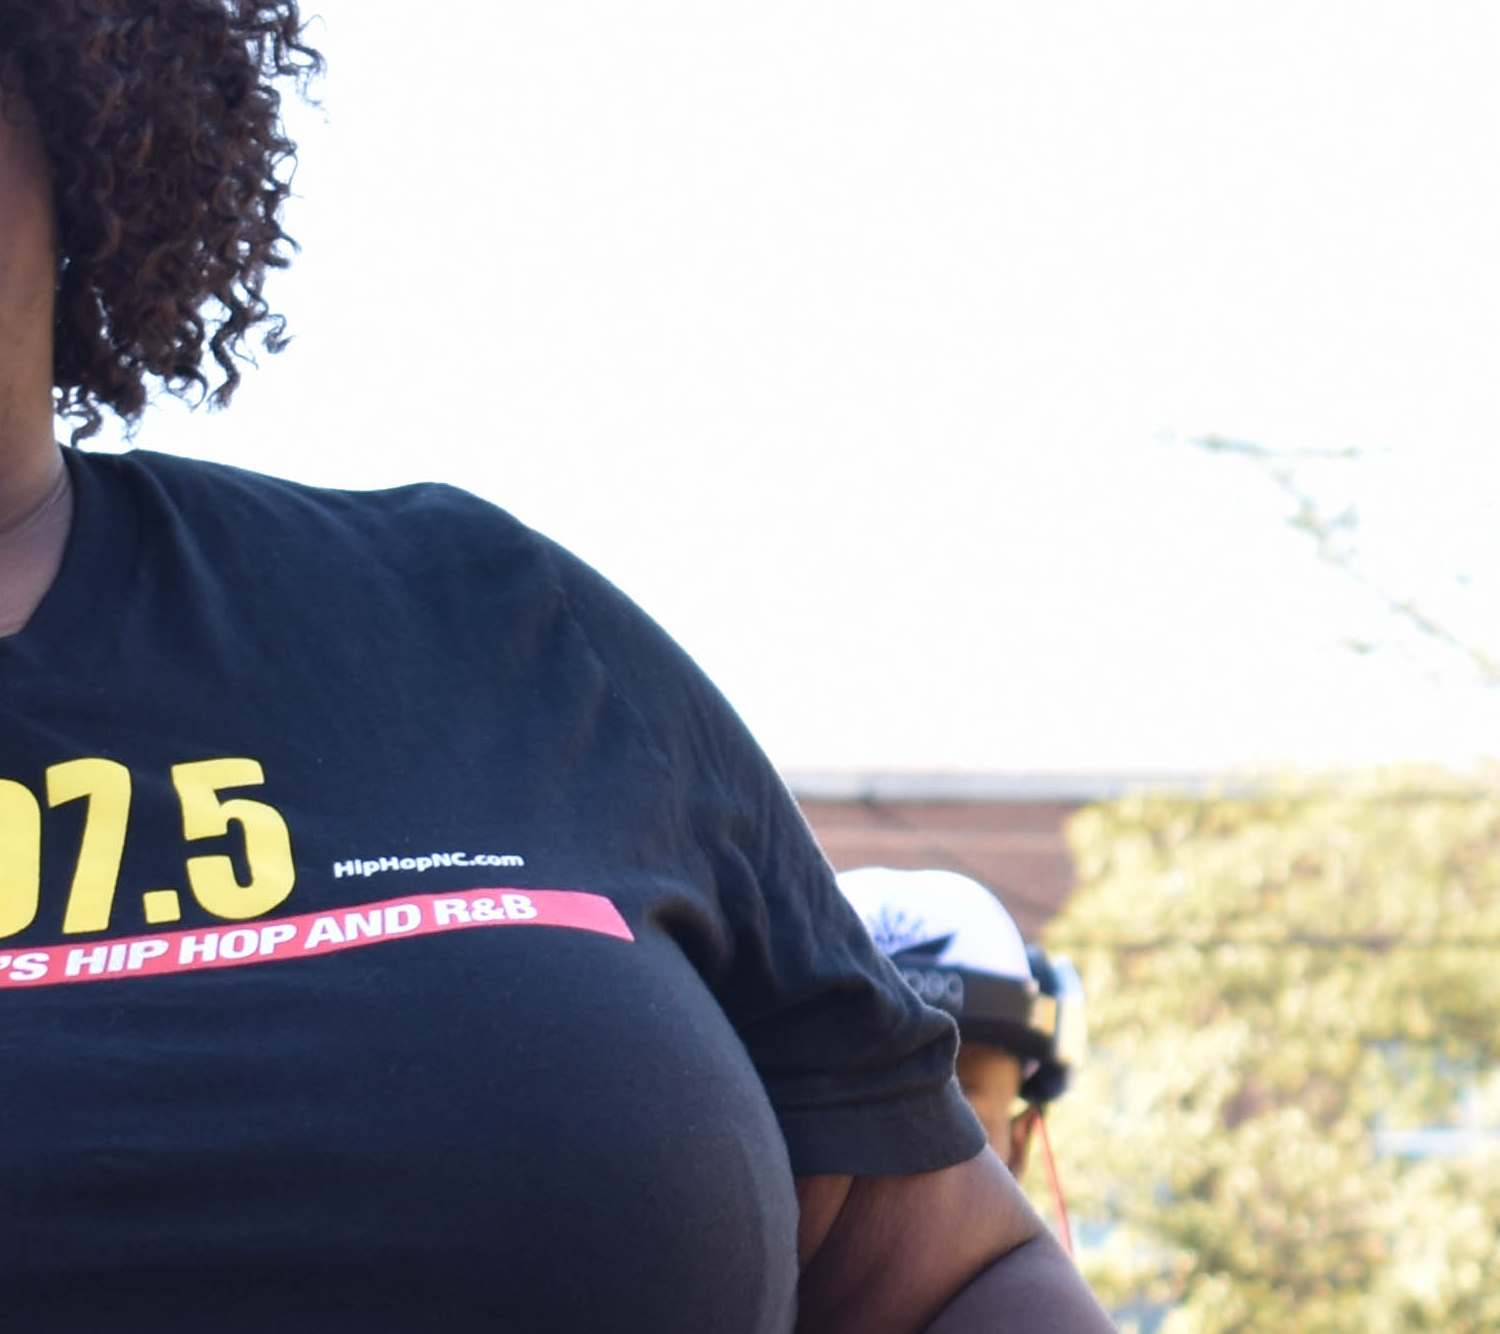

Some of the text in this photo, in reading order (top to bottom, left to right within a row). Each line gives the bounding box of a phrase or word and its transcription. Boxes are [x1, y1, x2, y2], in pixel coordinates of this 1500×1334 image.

[332, 851, 524, 881] HipHopNC.com
[62, 936, 169, 980] HIP
[177, 922, 303, 967] HOP
[303, 903, 425, 955] AND
[433, 891, 539, 926] R&B
